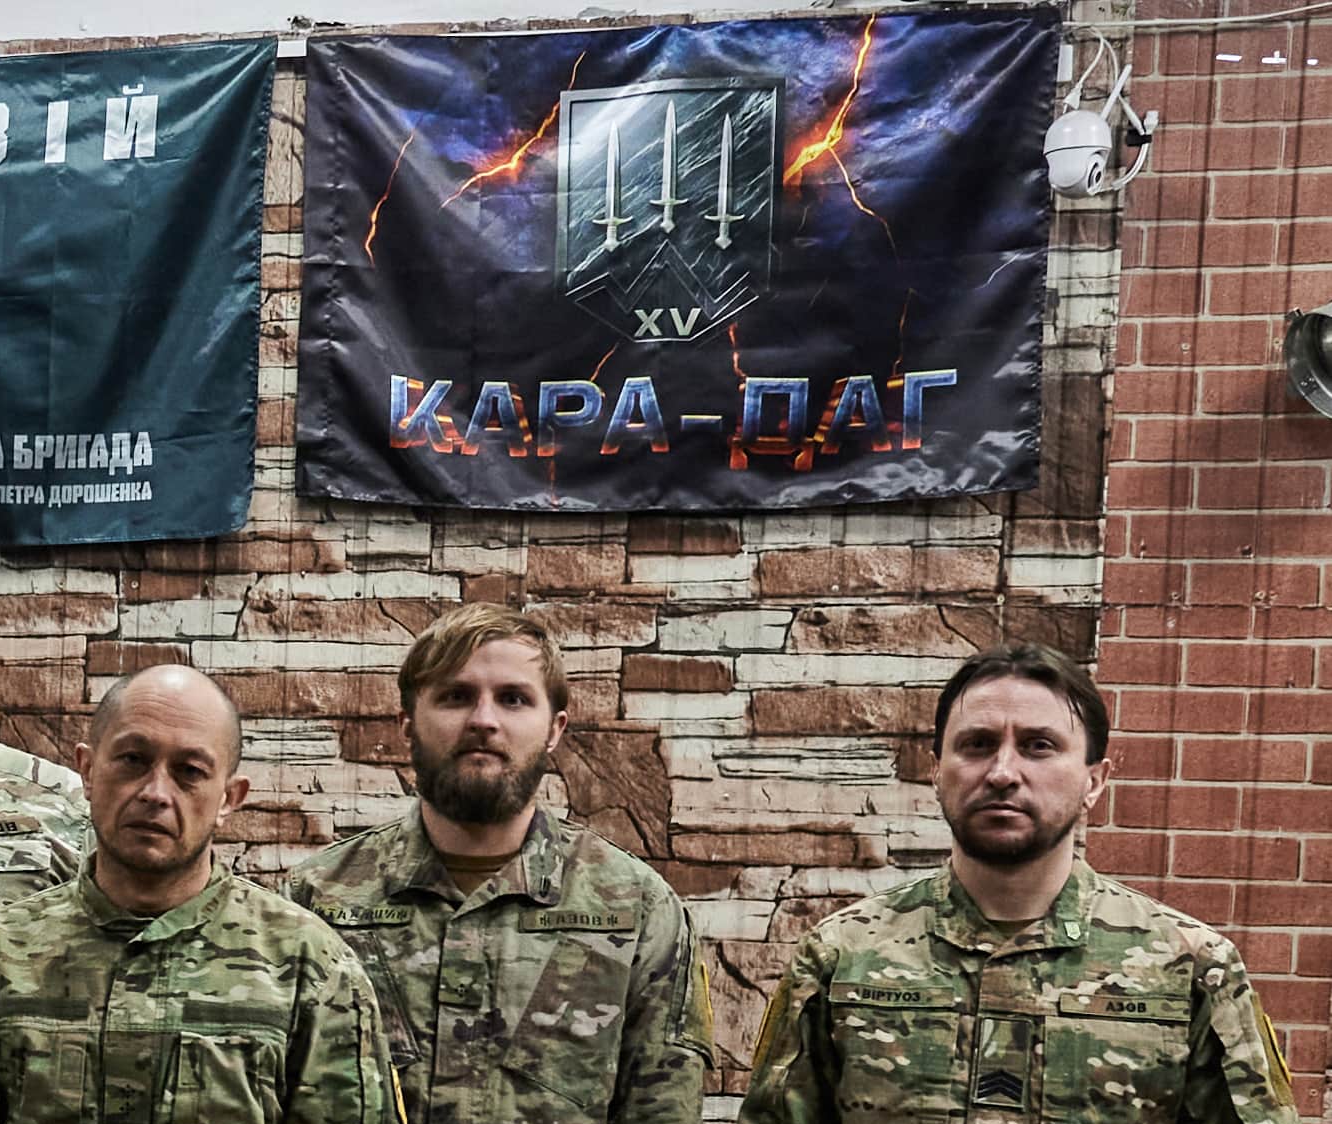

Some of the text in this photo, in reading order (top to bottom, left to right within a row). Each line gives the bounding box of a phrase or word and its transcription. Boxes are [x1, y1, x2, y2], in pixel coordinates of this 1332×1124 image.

[634, 307, 703, 337] XV
[389, 369, 960, 471] КАРА-ДАГ
[12, 431, 154, 476] БРИГАДА
[48, 481, 153, 508] ДОРОШЕНКА
[555, 911, 602, 926] АЗОВ
[861, 987, 921, 1002] ВІРТУОЗ
[1105, 1001, 1147, 1013] АЗОВ
